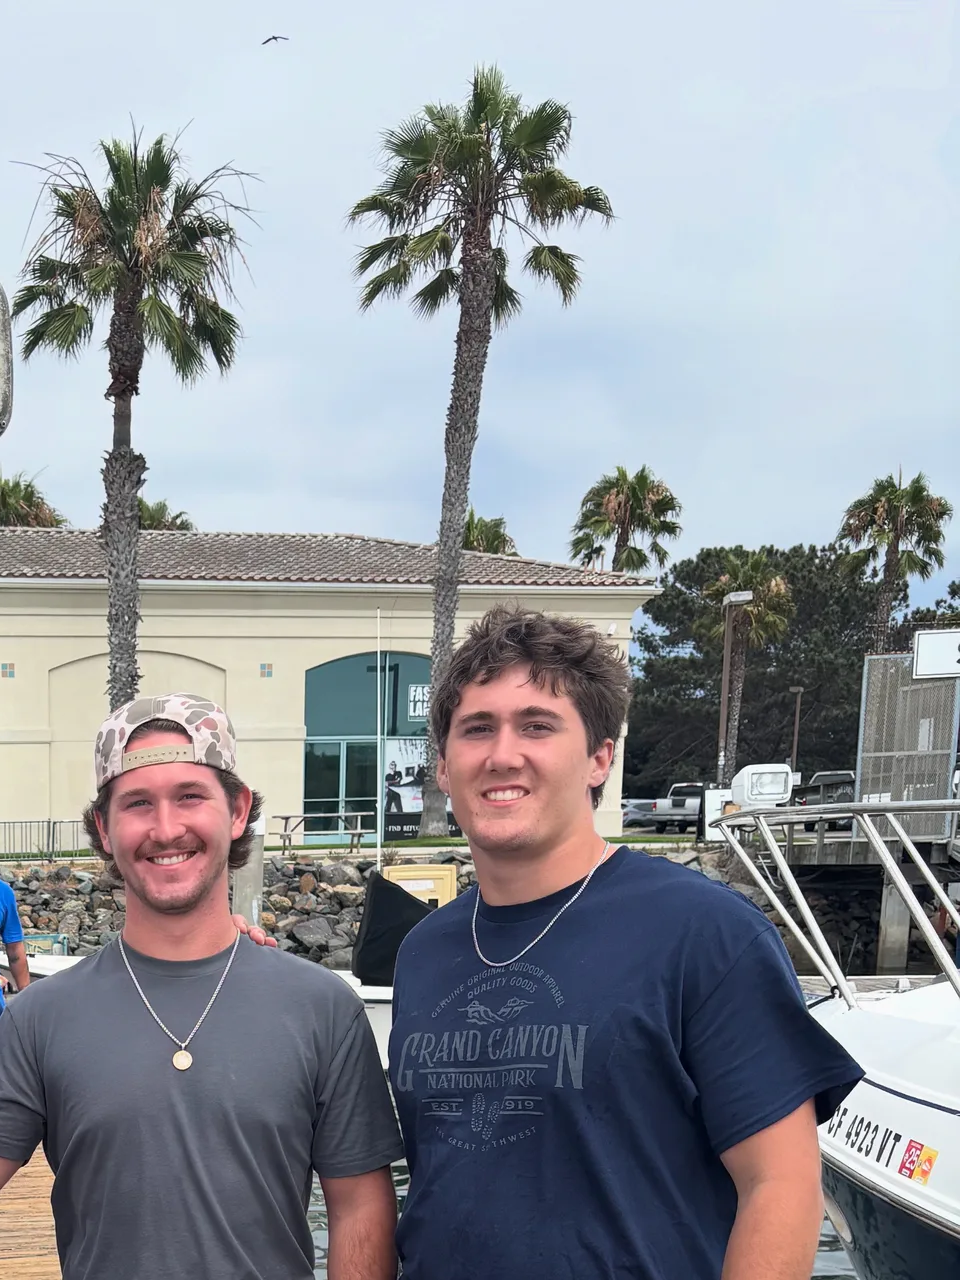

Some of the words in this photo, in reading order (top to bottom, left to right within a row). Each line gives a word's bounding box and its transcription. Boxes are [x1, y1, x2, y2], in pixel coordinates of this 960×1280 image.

[431, 984, 465, 1018] GENUINE
[467, 966, 506, 986] ORIGINAL
[509, 962, 544, 979] OUTDOOR
[542, 974, 566, 1009] APPAREL
[467, 977, 508, 1000] QUALITY
[509, 976, 538, 994] GOODS
[396, 1029, 482, 1092] GRAND
[487, 1023, 590, 1090] CANYON
[427, 1073, 499, 1089] NATIONAL
[501, 1069, 536, 1088] PARK
[431, 1102, 463, 1112] EST.
[448, 1137, 476, 1151] GREAT
[828, 1105, 848, 1138] CF
[845, 1115, 879, 1157] 4923
[876, 1128, 902, 1168] VT
